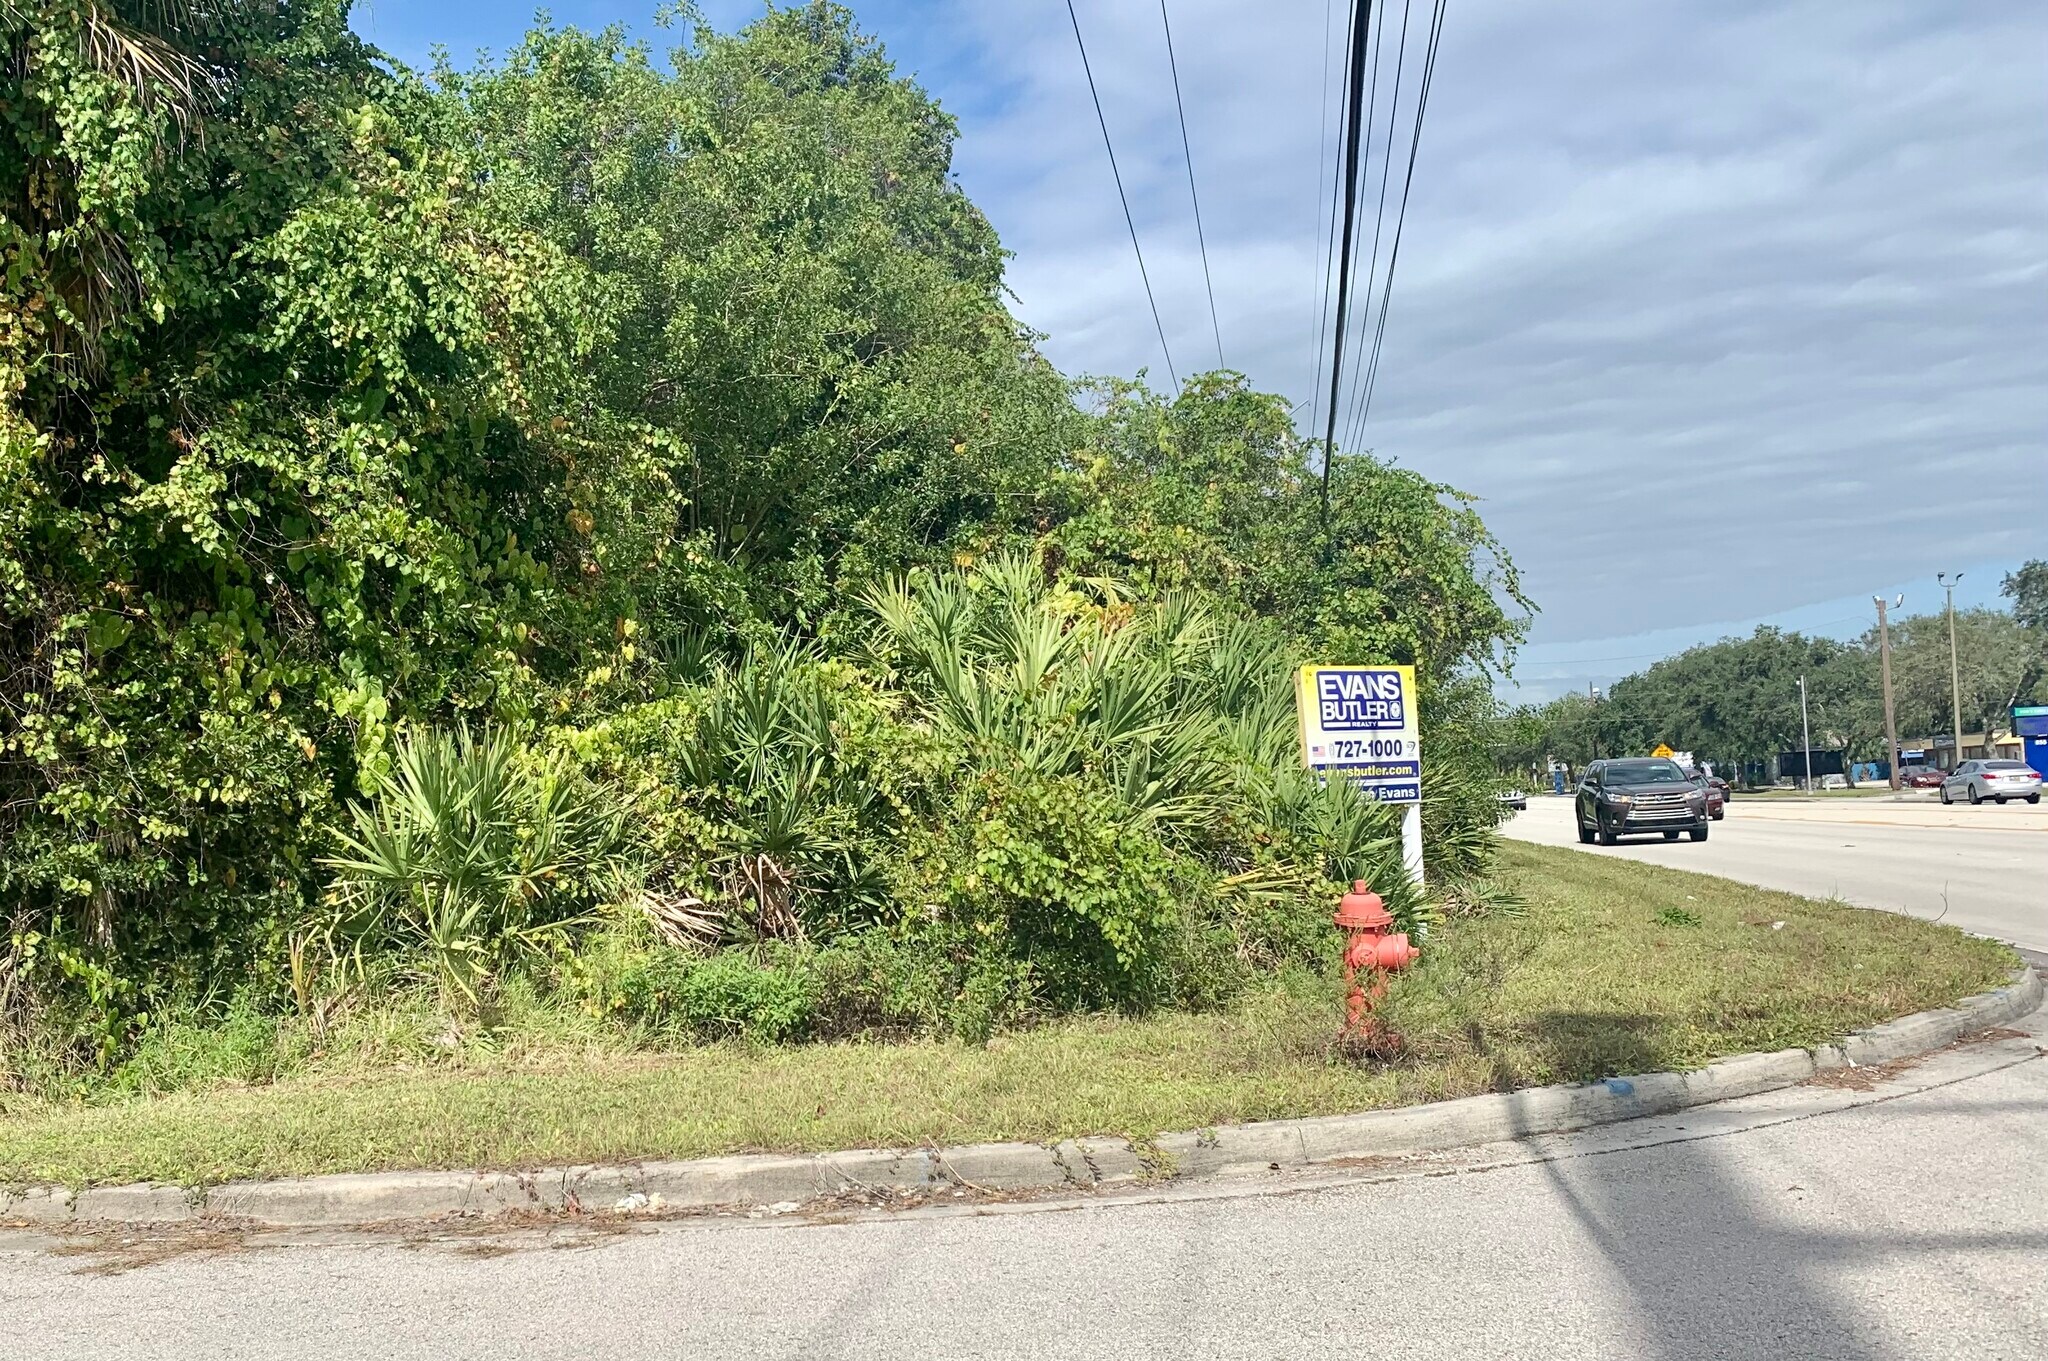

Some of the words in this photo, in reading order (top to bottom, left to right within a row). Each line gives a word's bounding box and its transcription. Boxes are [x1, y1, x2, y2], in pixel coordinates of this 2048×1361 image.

[1319, 674, 1400, 700] EVANS
[1322, 701, 1389, 720] BUTLER
[1334, 739, 1403, 758] 727-1000
[1378, 787, 1416, 799] Evans
